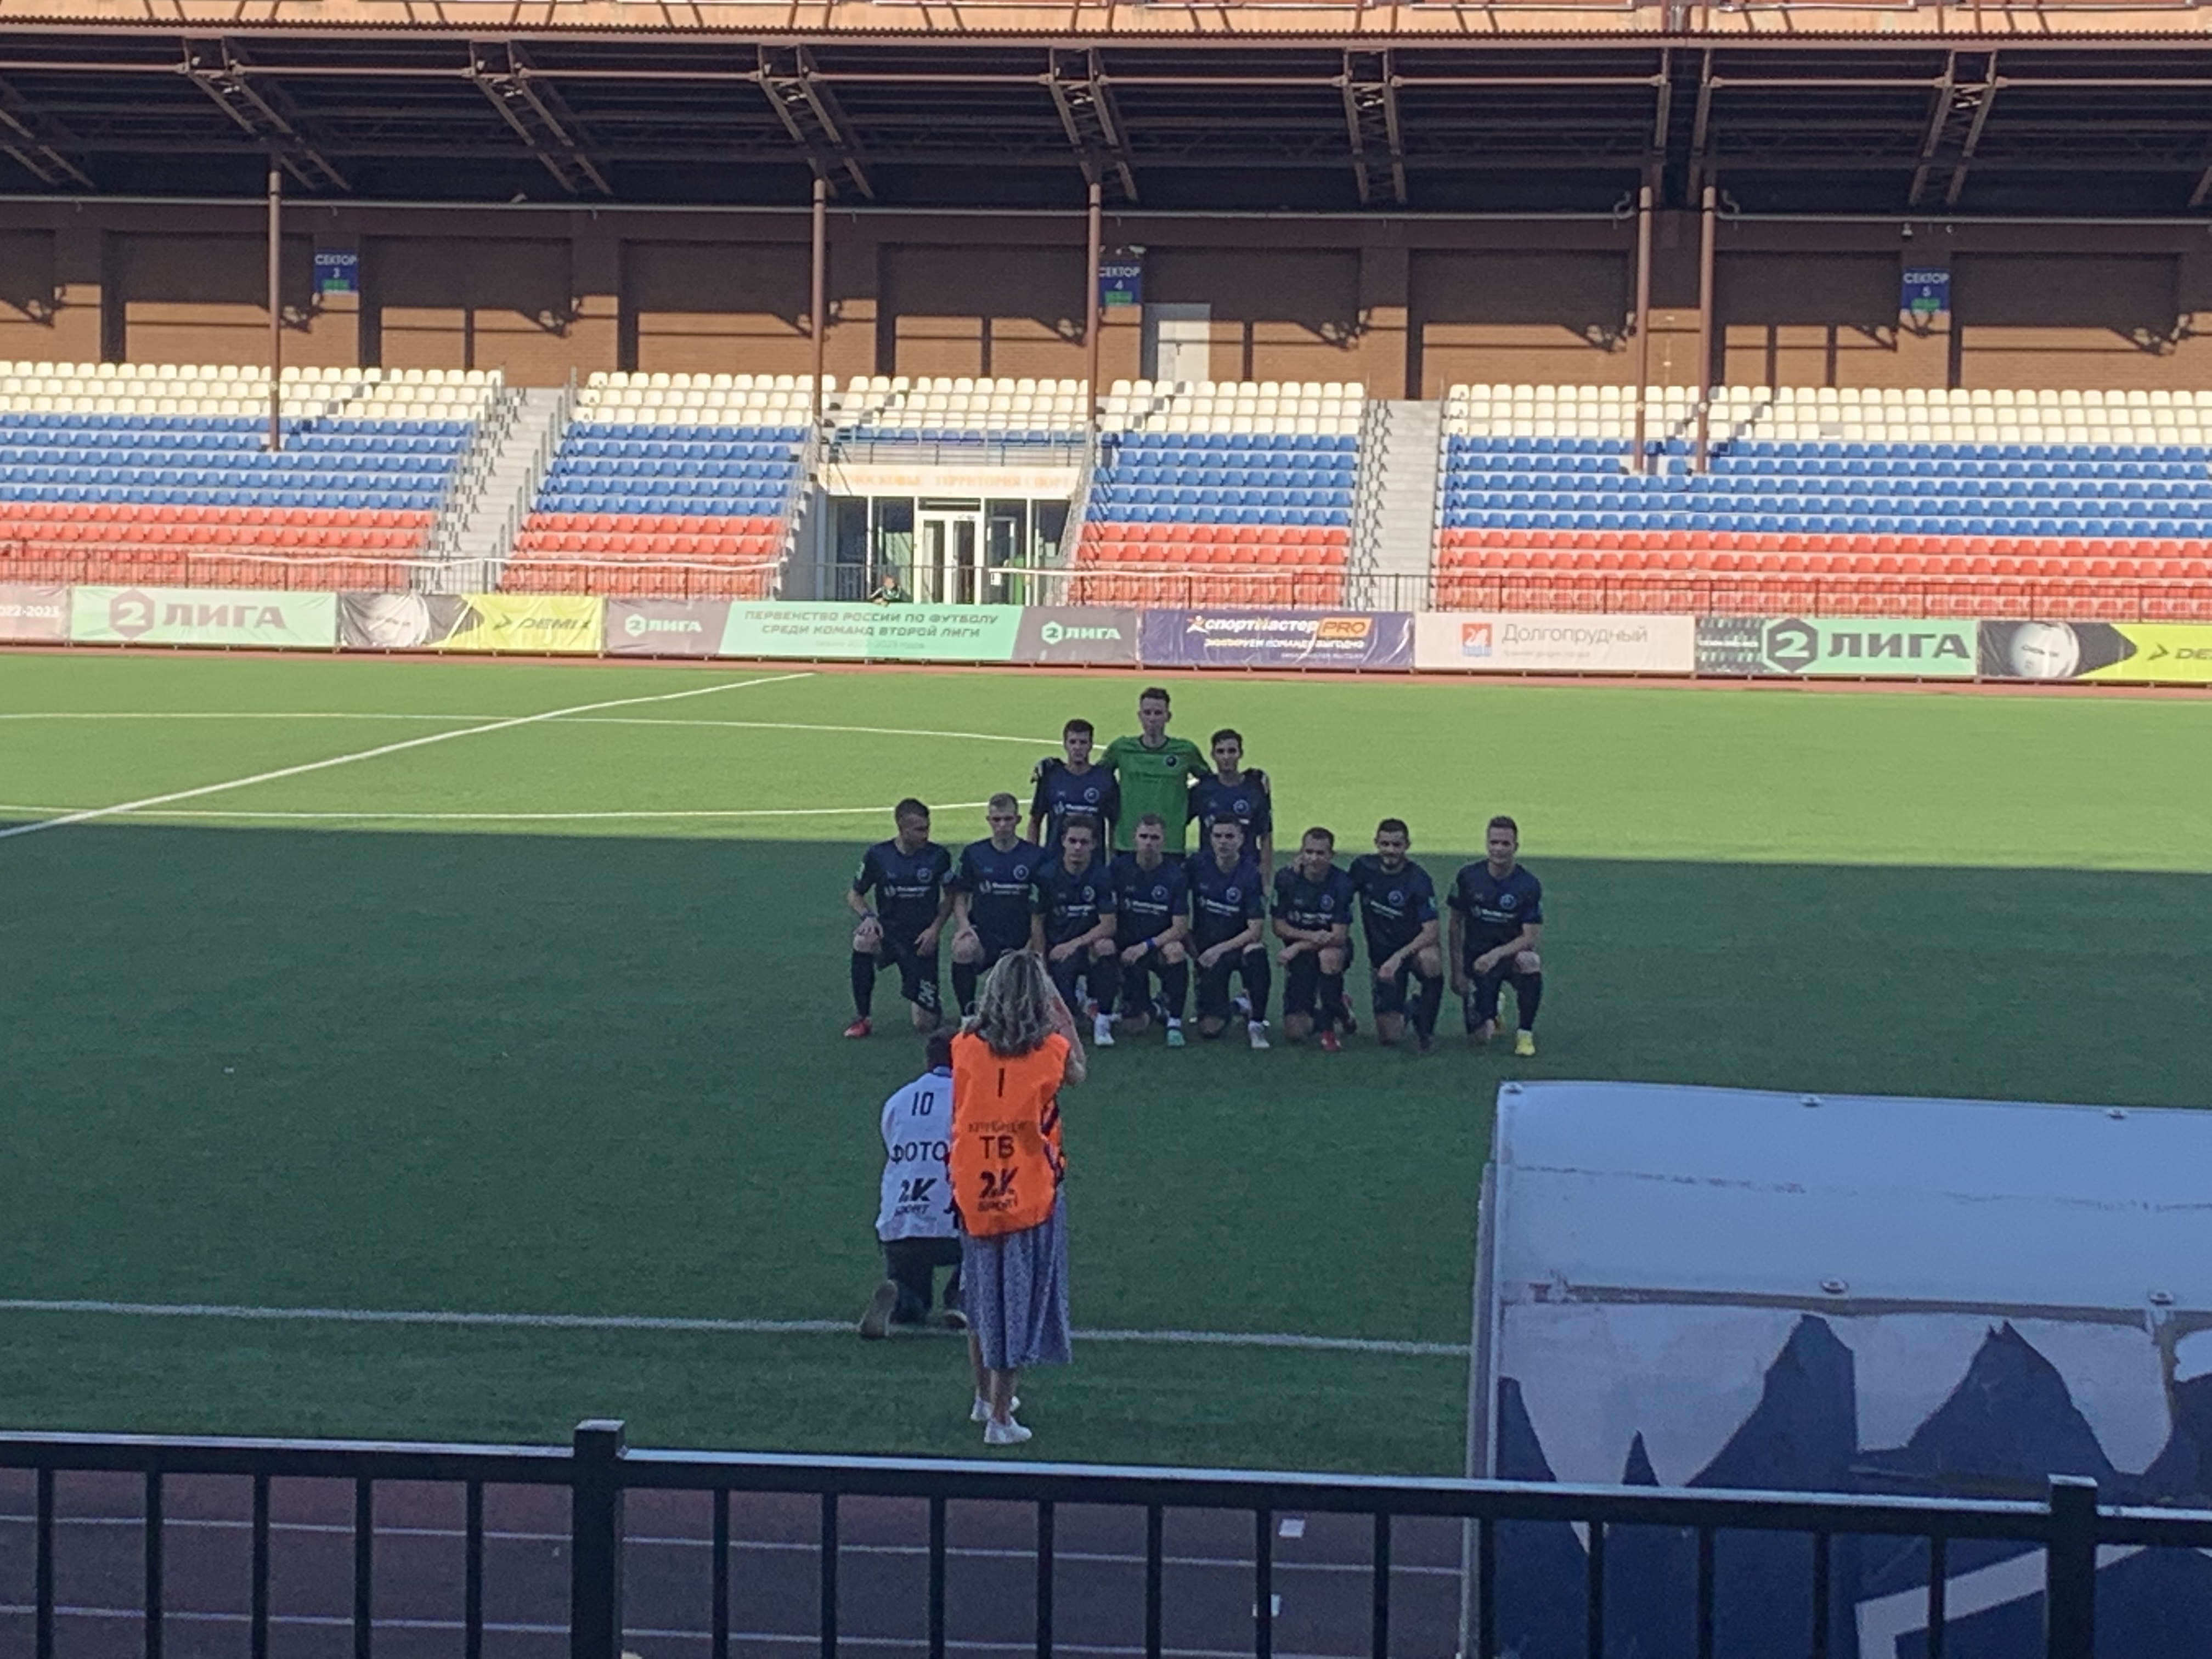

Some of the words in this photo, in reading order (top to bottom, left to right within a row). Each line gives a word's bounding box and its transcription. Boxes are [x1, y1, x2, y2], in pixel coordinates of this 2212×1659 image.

[314, 253, 358, 266] СЕКТОР
[1114, 279, 1124, 290] 4
[1903, 273, 1950, 284] СЕКТОР
[162, 603, 287, 629] ЛИГА
[744, 610, 839, 621] ПЕРВЕНСТВО
[843, 612, 901, 623] РОССИИ
[905, 613, 926, 623] ПО
[929, 613, 998, 624] ФУТБОЛУ
[647, 619, 703, 633] ЛИГА
[761, 624, 809, 635] СРЕДИ
[813, 625, 875, 636] КОМАНД
[878, 625, 938, 636] ВТОРОЙ
[940, 628, 981, 637] ЛИГИ
[1323, 620, 1365, 634] PRO
[1065, 627, 1121, 640] ЛИГА
[1502, 623, 1648, 644] Долгопрудный
[1827, 633, 1971, 659] ЛИГА
[2175, 648, 2212, 661] DE
[911, 1092, 934, 1116] 10
[891, 1141, 949, 1164] ФОТО
[979, 1136, 1015, 1159] ТВ
[898, 1177, 937, 1203] 2K
